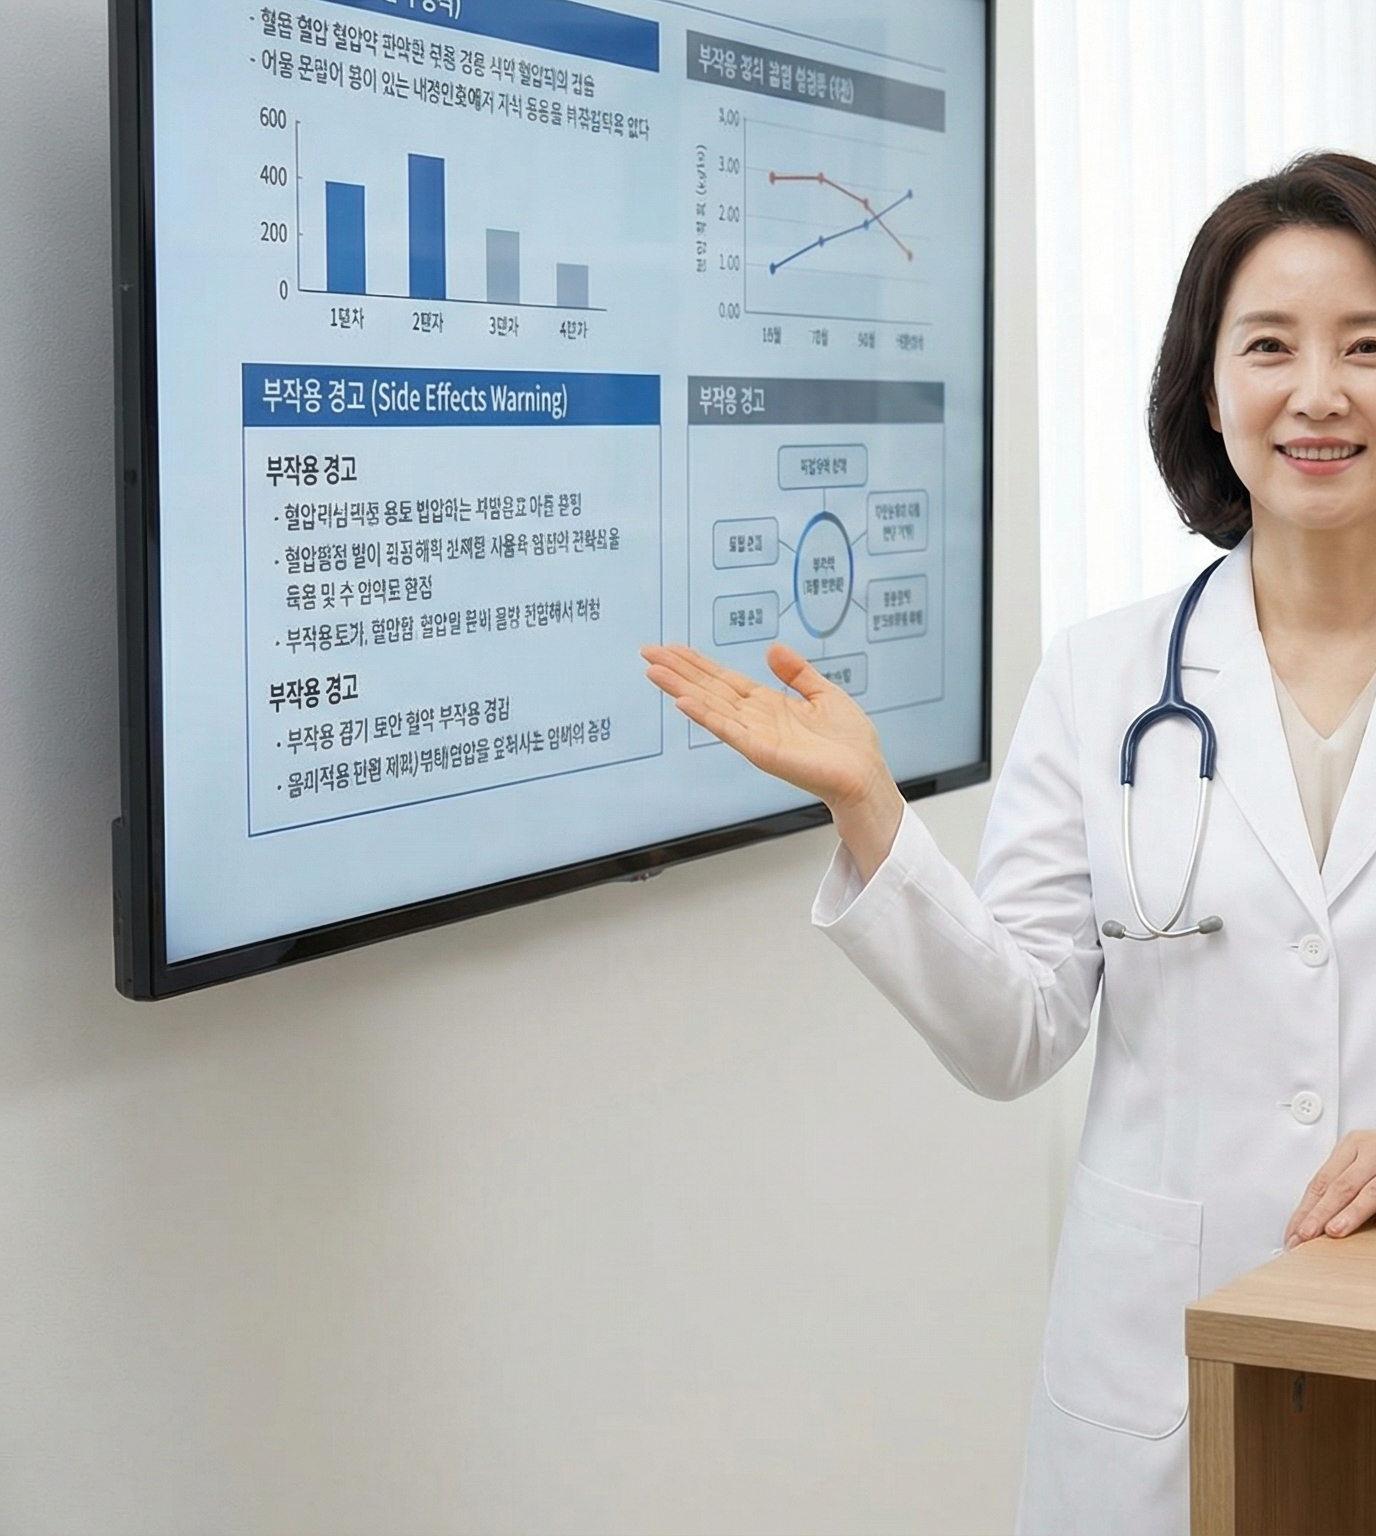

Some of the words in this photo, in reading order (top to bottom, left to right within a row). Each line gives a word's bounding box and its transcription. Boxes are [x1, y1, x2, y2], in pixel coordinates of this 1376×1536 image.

[259, 108, 287, 130] 600
[259, 166, 288, 187] 400
[259, 222, 288, 244] 200
[280, 280, 288, 301] 0
[262, 377, 322, 414] 부작용
[328, 378, 365, 414] 경고
[371, 379, 420, 418] (Side
[426, 382, 487, 413] Effects
[490, 383, 568, 420] Warning)
[266, 454, 319, 487] 부작용
[324, 453, 357, 485] 경고
[269, 678, 320, 713] 부작용
[326, 673, 358, 705] 경고
[287, 723, 334, 755] 부작용
[439, 701, 480, 730] 부작용
